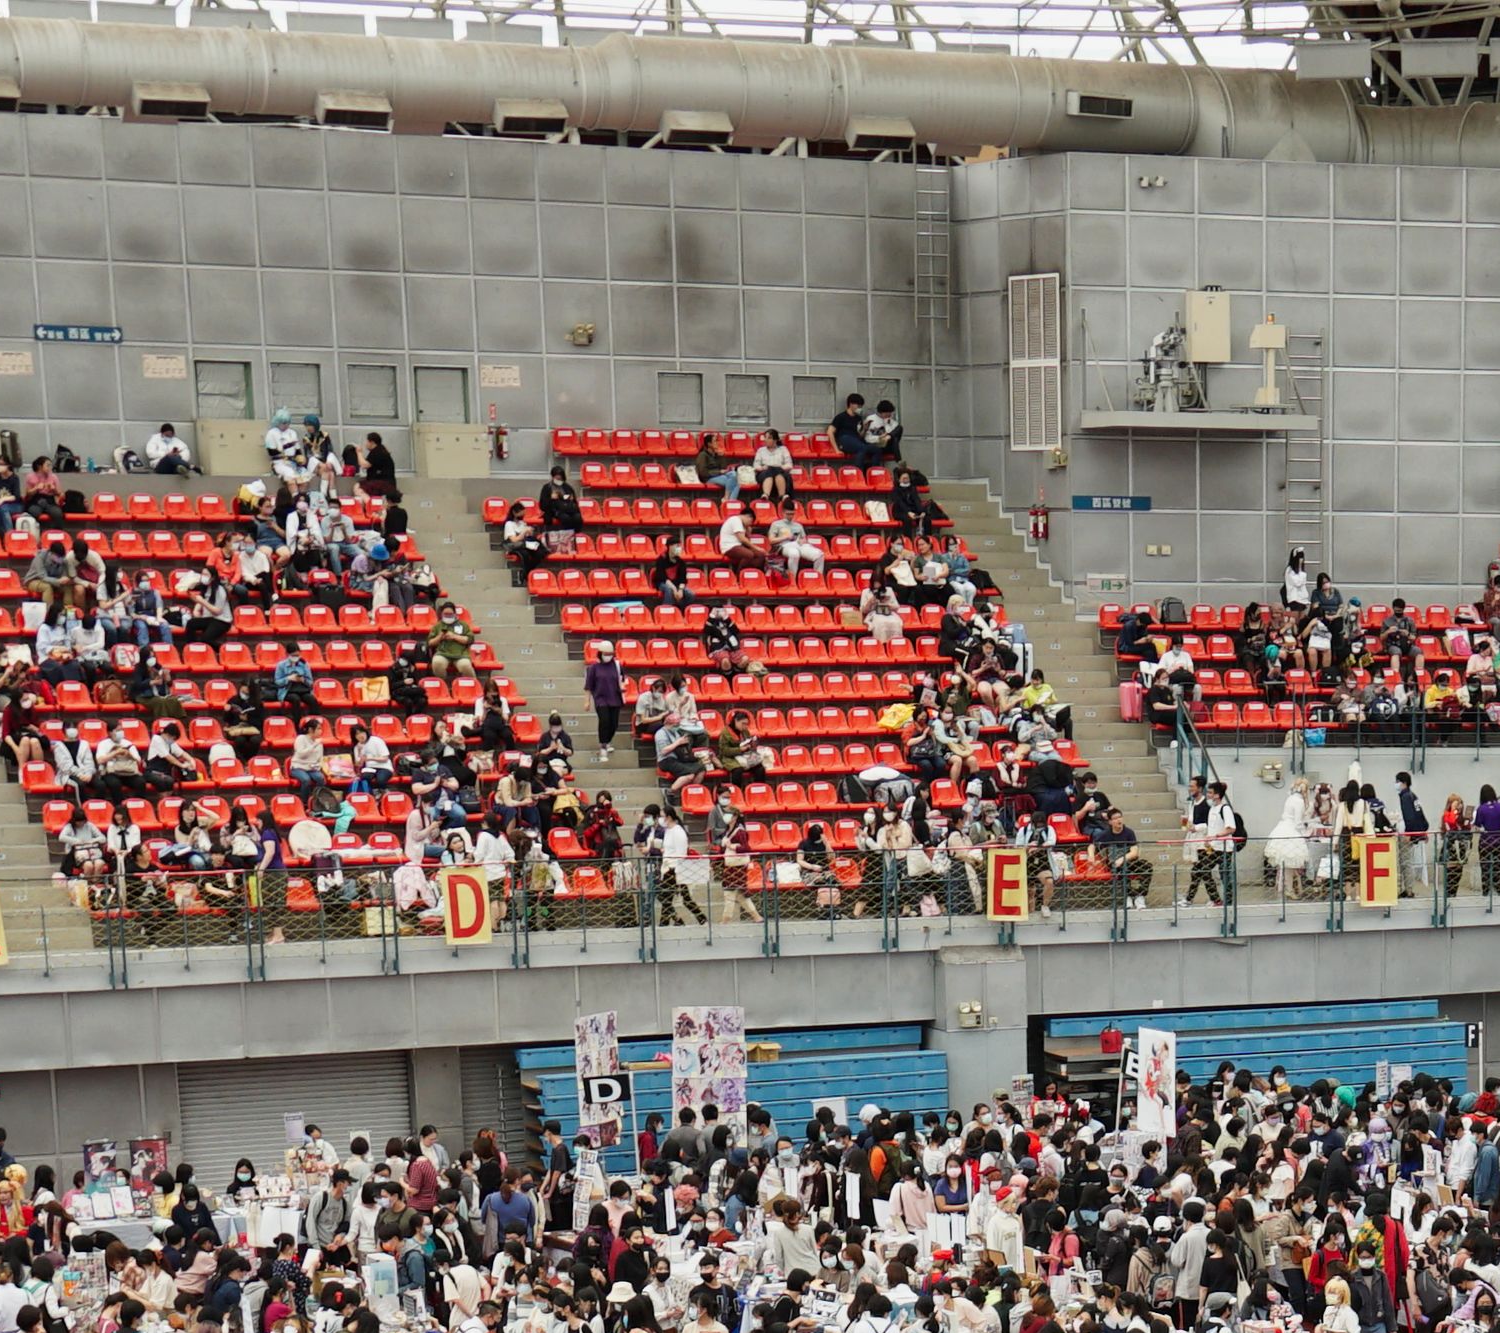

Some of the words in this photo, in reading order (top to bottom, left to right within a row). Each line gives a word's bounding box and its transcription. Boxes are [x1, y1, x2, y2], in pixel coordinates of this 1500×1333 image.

[993, 855, 1021, 916] E
[1366, 842, 1390, 902] F
[447, 874, 485, 939] D
[1468, 1024, 1476, 1047] F
[589, 1078, 622, 1104] D
